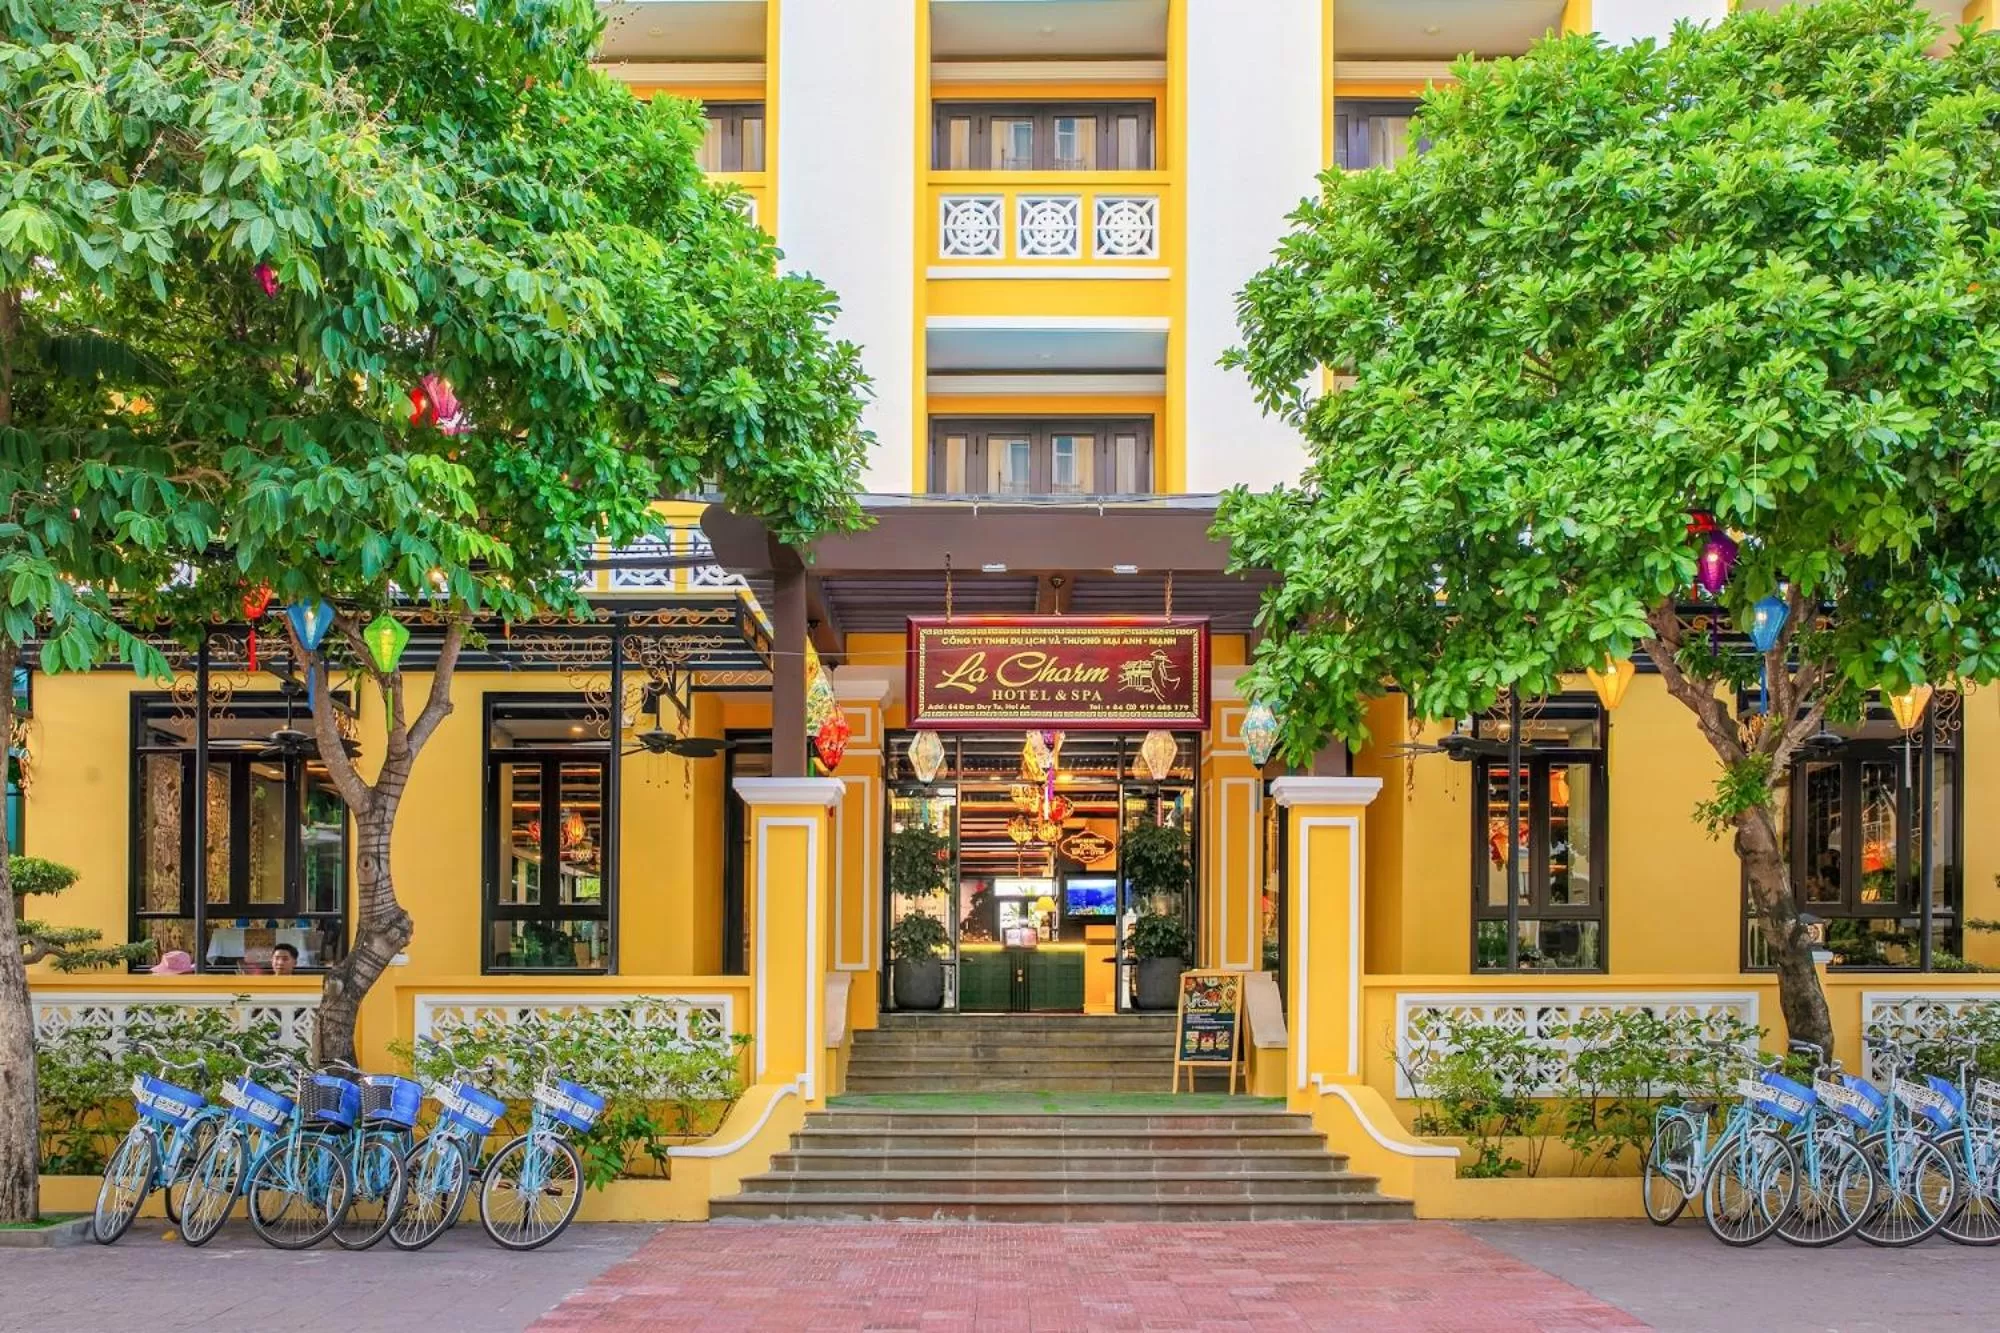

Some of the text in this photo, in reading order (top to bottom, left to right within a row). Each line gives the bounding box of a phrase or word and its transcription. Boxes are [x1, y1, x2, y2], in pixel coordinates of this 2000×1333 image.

[971, 636, 982, 645] TY
[983, 636, 1009, 645] TNHH
[1010, 636, 1023, 645] DU
[1121, 636, 1142, 645] ANH
[934, 651, 1110, 694] La Charm
[991, 689, 1102, 701] HOTEL & SPA
[976, 703, 992, 711] Duy
